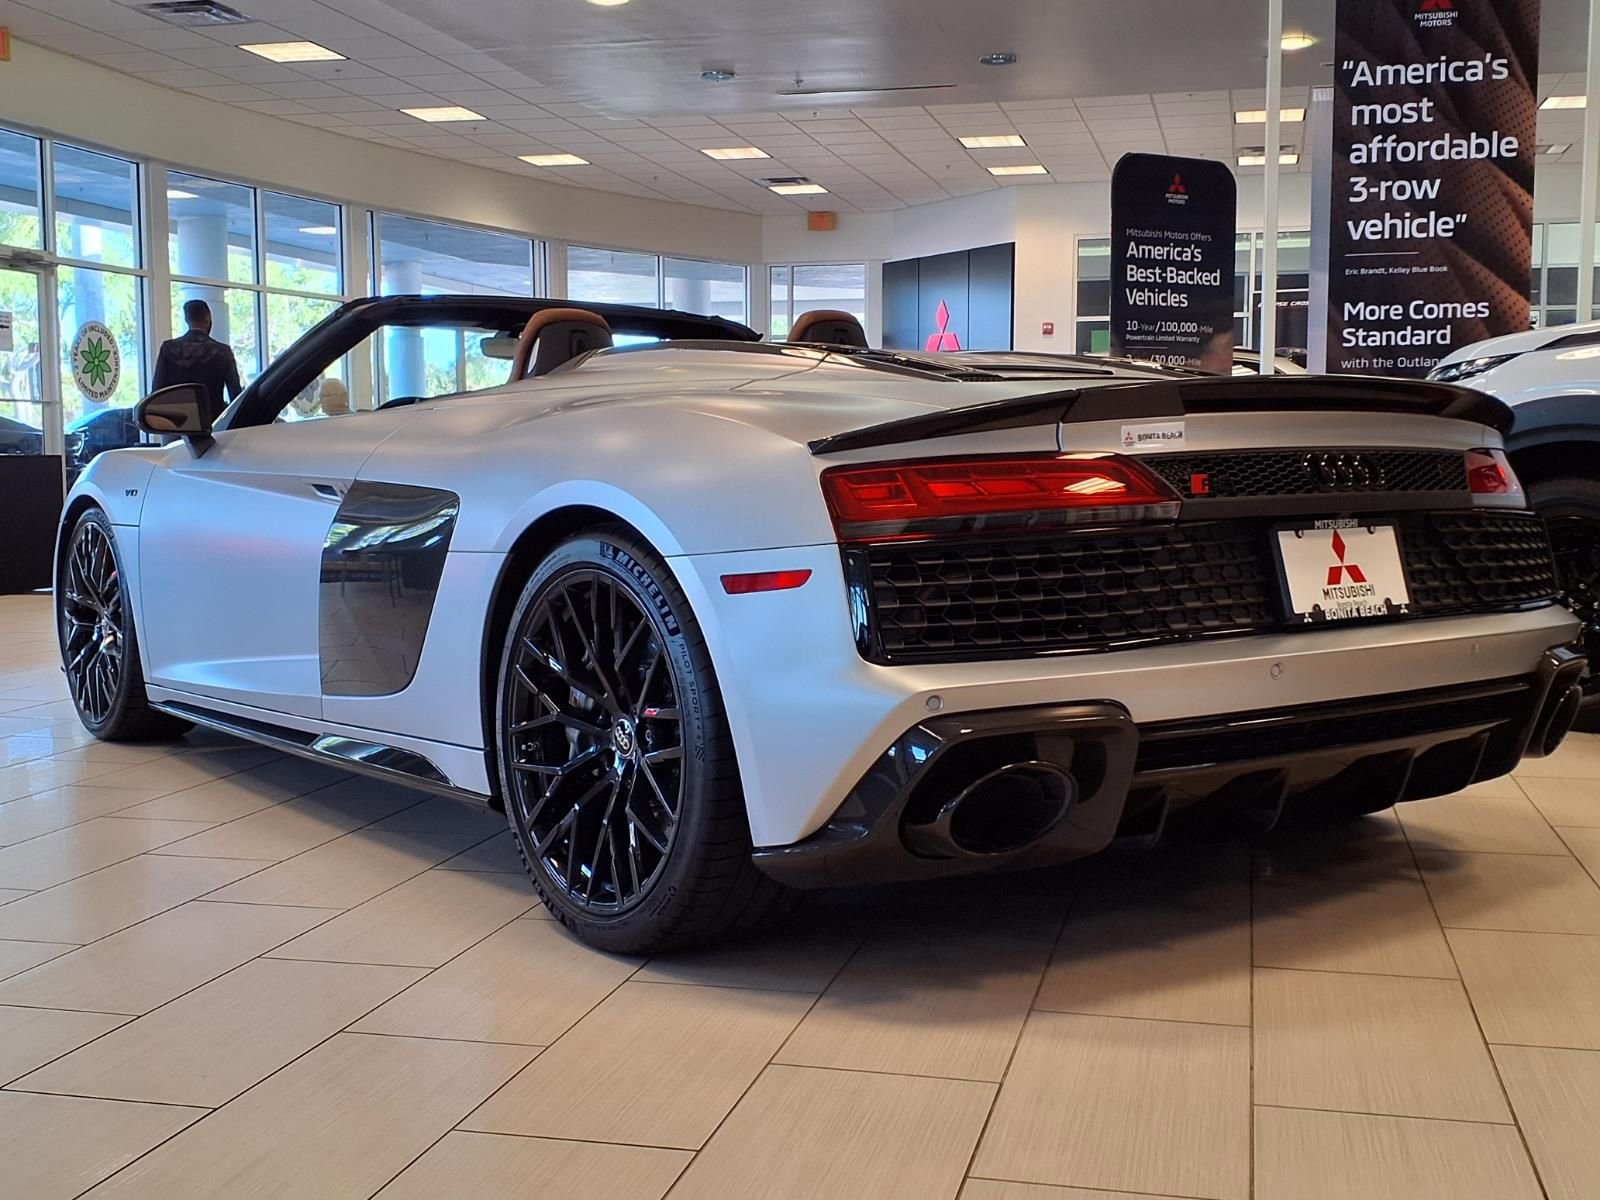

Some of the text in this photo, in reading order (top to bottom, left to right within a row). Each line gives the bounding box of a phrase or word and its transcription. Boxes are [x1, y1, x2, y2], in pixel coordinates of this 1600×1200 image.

[1414, 11, 1458, 20] MITSUBISHI
[1420, 19, 1452, 27] MOTORS
[1351, 97, 1433, 126] most
[1349, 131, 1518, 164] affordable
[1349, 176, 1441, 201] 3-row
[1126, 228, 1212, 241] Mitsubishi Motors Offers
[1126, 241, 1202, 262] America’s
[1126, 264, 1220, 286] Best-Backed
[1360, 267, 1387, 275] Brandt,
[1388, 266, 1411, 275] Kelley
[1411, 265, 1428, 273] Blue
[1429, 265, 1448, 273] Book
[1125, 287, 1189, 307] Vehicles
[1343, 301, 1490, 321] More Comes
[1125, 333, 1155, 341] Powertrain
[1176, 335, 1200, 344] Warranty
[1342, 325, 1451, 347] Standard
[1341, 358, 1369, 369] with
[1373, 357, 1394, 368] the
[78, 376, 99, 399] LIMITED
[1138, 432, 1160, 442] BONITA
[1315, 519, 1359, 529] MITSUBISHI
[616, 551, 678, 631] MICHELIN
[1322, 584, 1376, 600] MITSUBISHI
[1325, 607, 1359, 620] BONITA
[1360, 603, 1388, 617] BEACH
[679, 642, 693, 675] PILOT
[689, 681, 700, 721] SPORT
